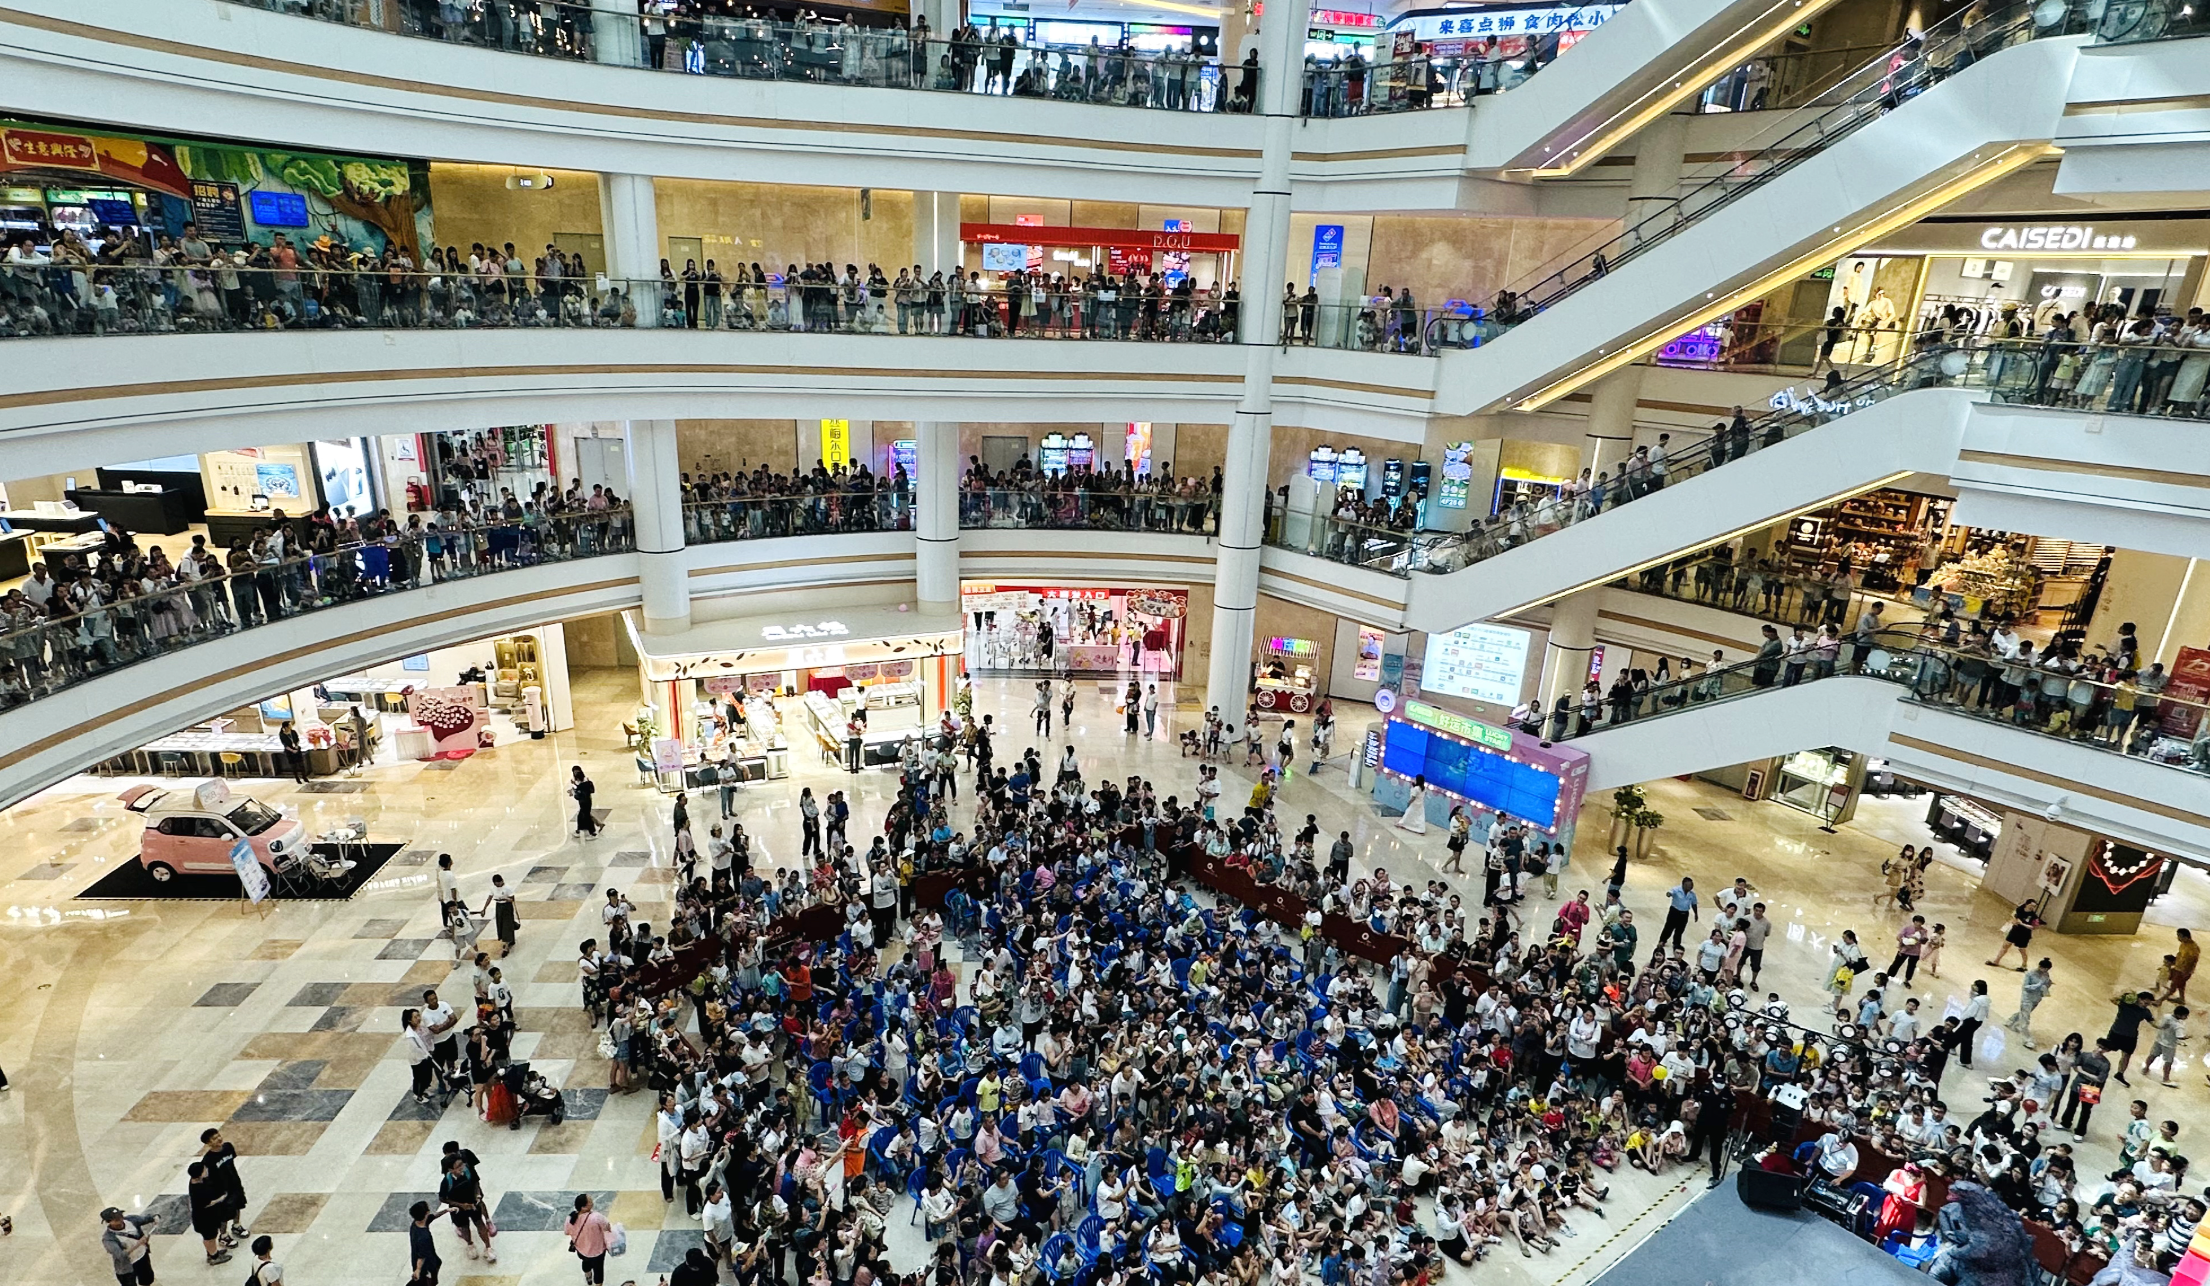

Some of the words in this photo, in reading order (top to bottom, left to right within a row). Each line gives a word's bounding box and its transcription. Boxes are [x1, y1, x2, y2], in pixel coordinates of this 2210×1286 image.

[1438, 15, 1516, 35] 来喜点狮
[1981, 226, 2094, 249] CAISEDI
[1439, 713, 1484, 740] 好运市集
